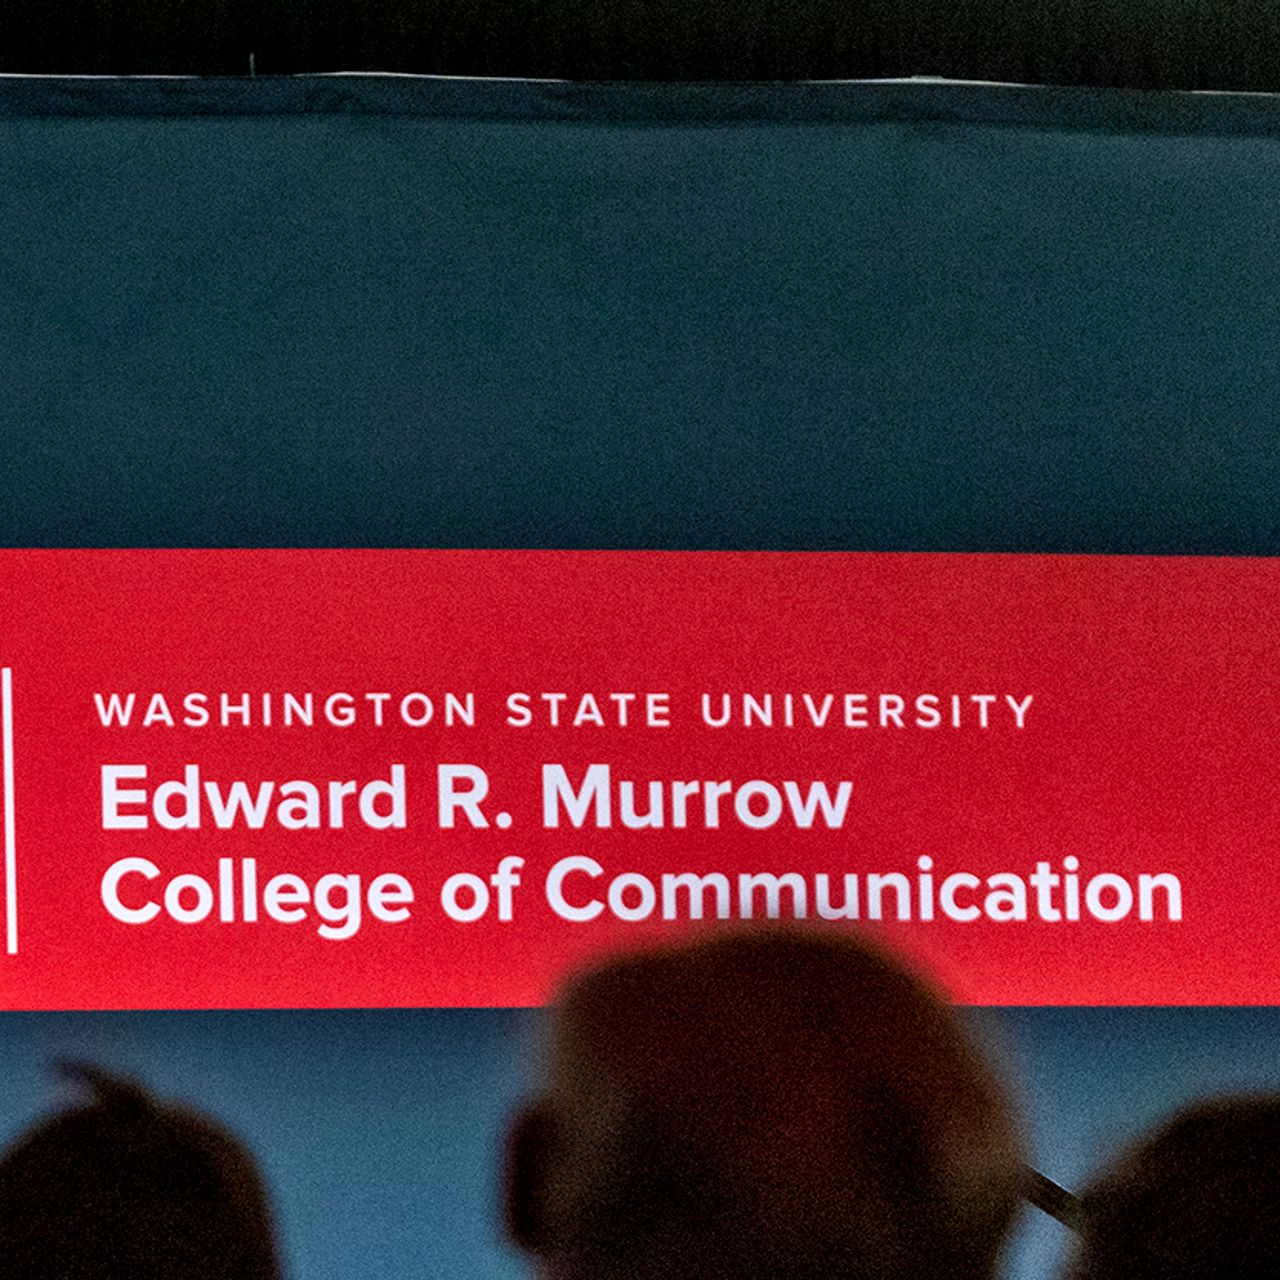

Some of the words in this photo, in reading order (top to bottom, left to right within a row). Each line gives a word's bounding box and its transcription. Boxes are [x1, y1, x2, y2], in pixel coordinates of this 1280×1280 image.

[94, 692, 474, 728] WASHINGTON
[507, 692, 671, 728] STATE
[701, 693, 1034, 729] UNIVERSITY
[100, 763, 407, 831] Edward
[437, 763, 513, 830] R.
[542, 763, 853, 830] Murrow
[100, 856, 414, 941] College
[440, 855, 524, 924] of
[545, 853, 1184, 926] Communication
